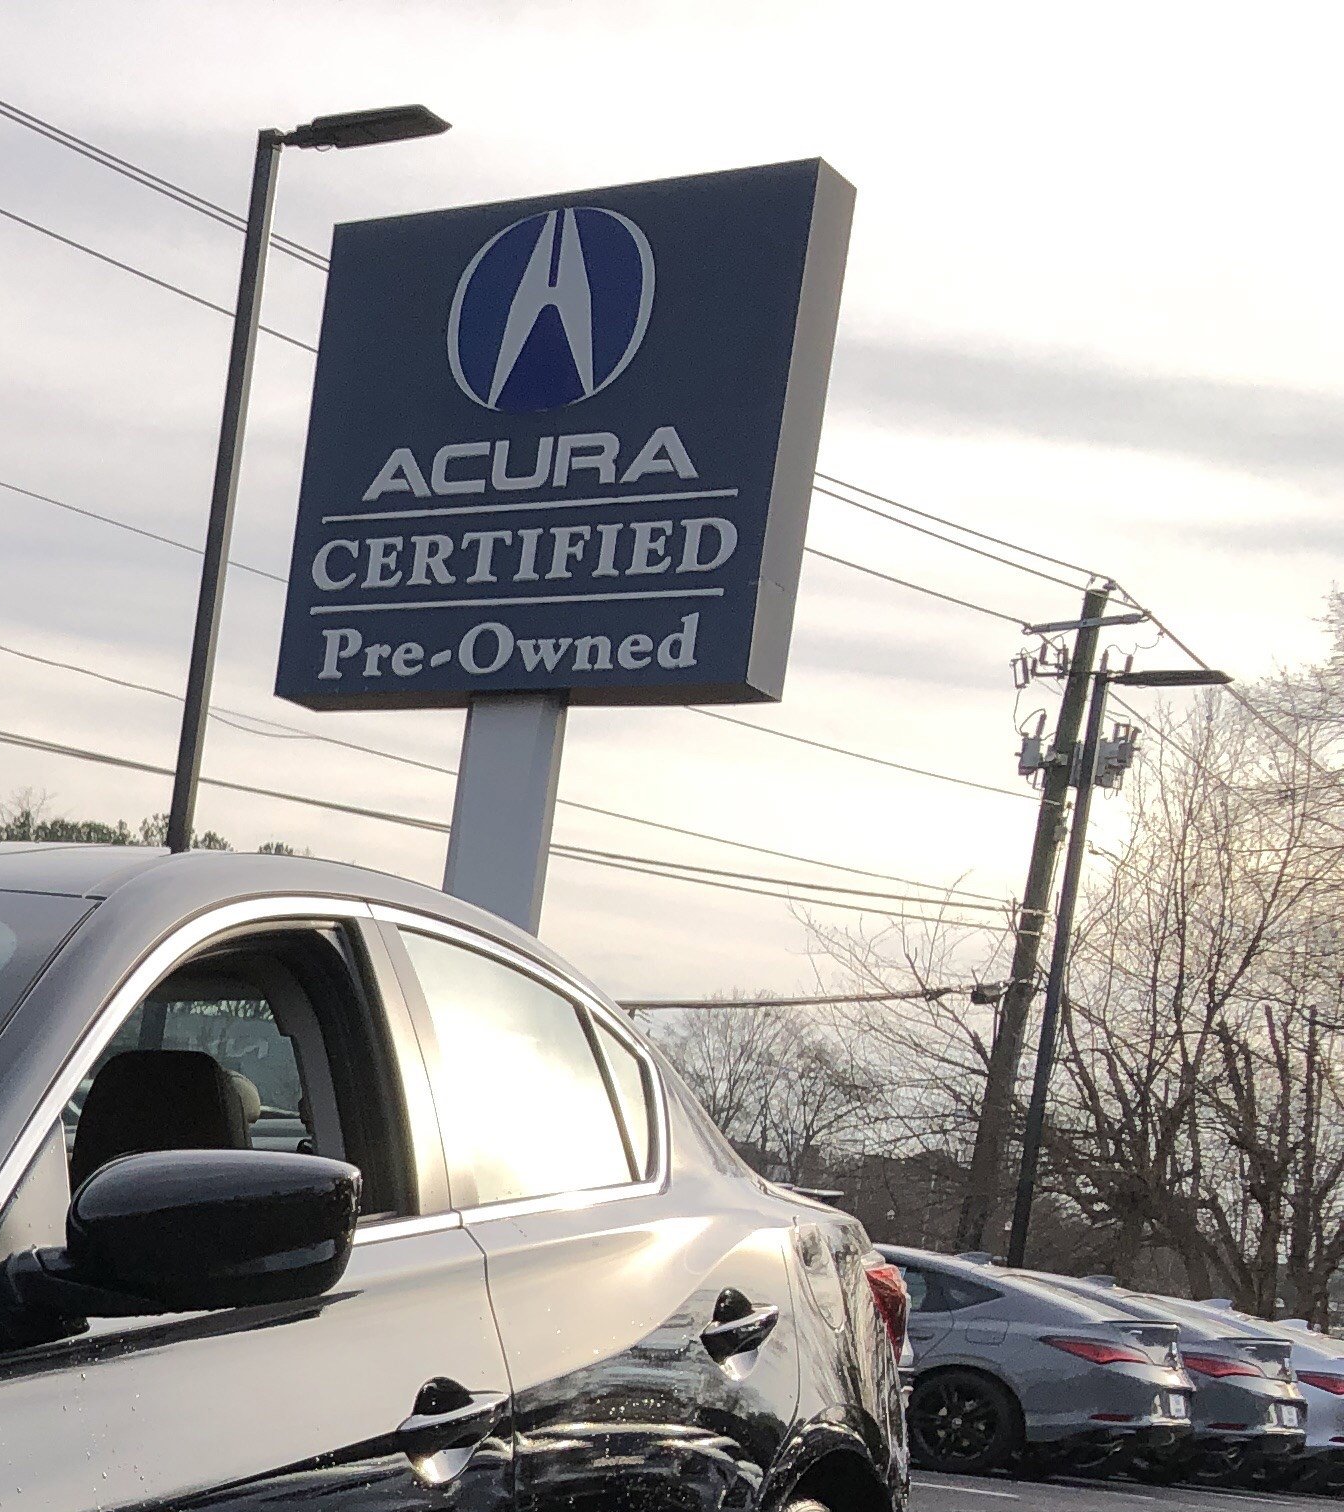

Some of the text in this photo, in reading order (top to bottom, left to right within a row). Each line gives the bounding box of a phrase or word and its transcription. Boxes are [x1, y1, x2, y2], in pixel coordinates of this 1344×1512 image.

[362, 426, 699, 500] ACURA
[311, 516, 739, 591] CERTIFIED
[317, 611, 700, 680] Pre-Owned
